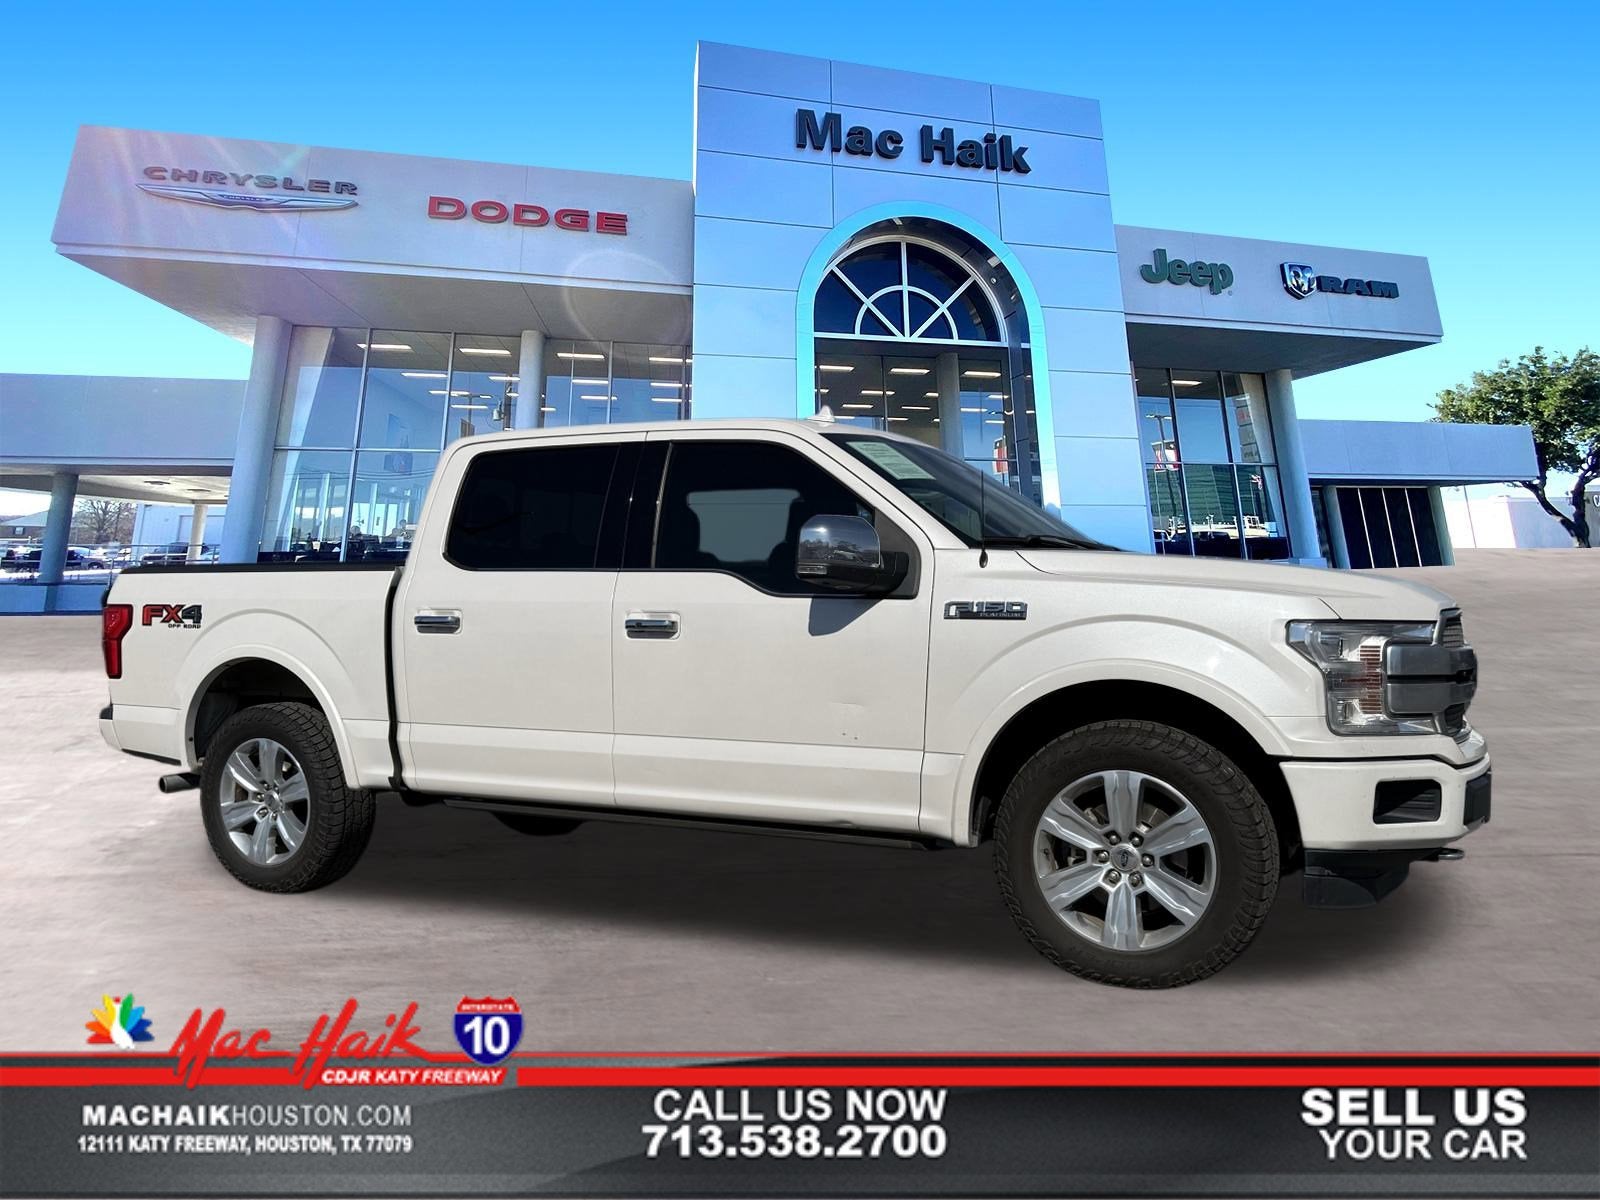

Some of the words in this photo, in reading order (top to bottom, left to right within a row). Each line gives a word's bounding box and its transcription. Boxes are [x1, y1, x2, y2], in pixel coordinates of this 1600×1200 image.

[795, 108, 904, 160] Mac
[920, 123, 1032, 175] Haik
[143, 166, 358, 196] CHRYSLER
[427, 195, 629, 236] DODGE
[1140, 248, 1234, 296] Jeep
[1316, 275, 1400, 299] RAM
[142, 604, 202, 626] FX4
